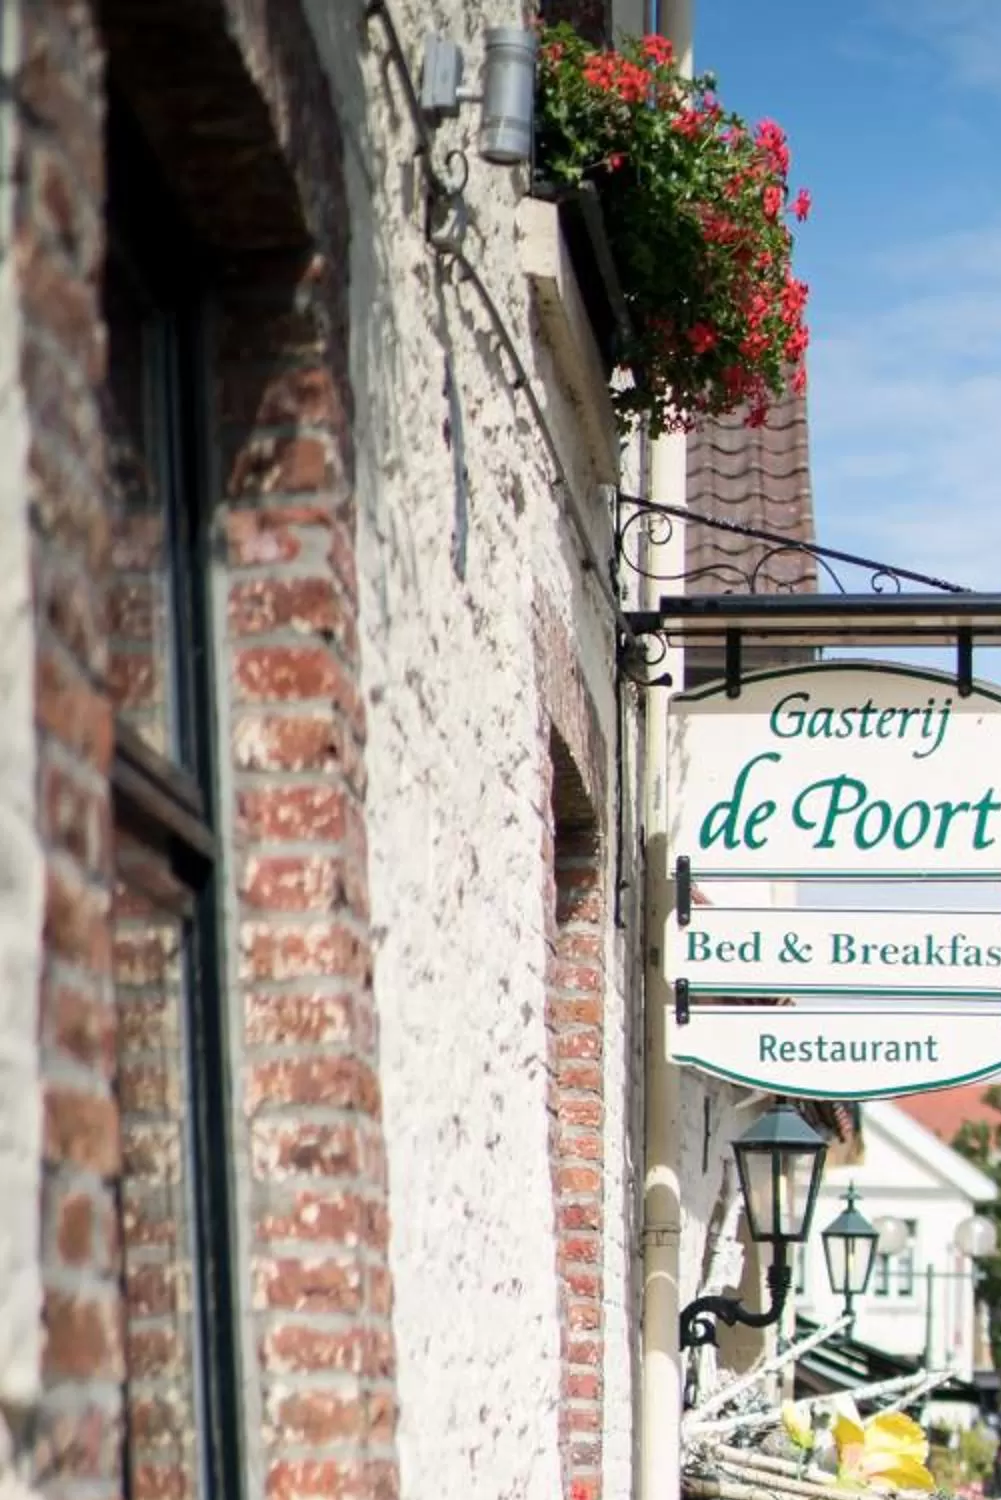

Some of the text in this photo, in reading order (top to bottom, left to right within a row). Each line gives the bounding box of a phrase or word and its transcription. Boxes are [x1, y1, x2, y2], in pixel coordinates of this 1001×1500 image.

[769, 691, 953, 758] Gasterij
[698, 751, 783, 851] de
[686, 930, 762, 962] Bed
[777, 932, 814, 964] &
[758, 1033, 939, 1063] Restaurant
